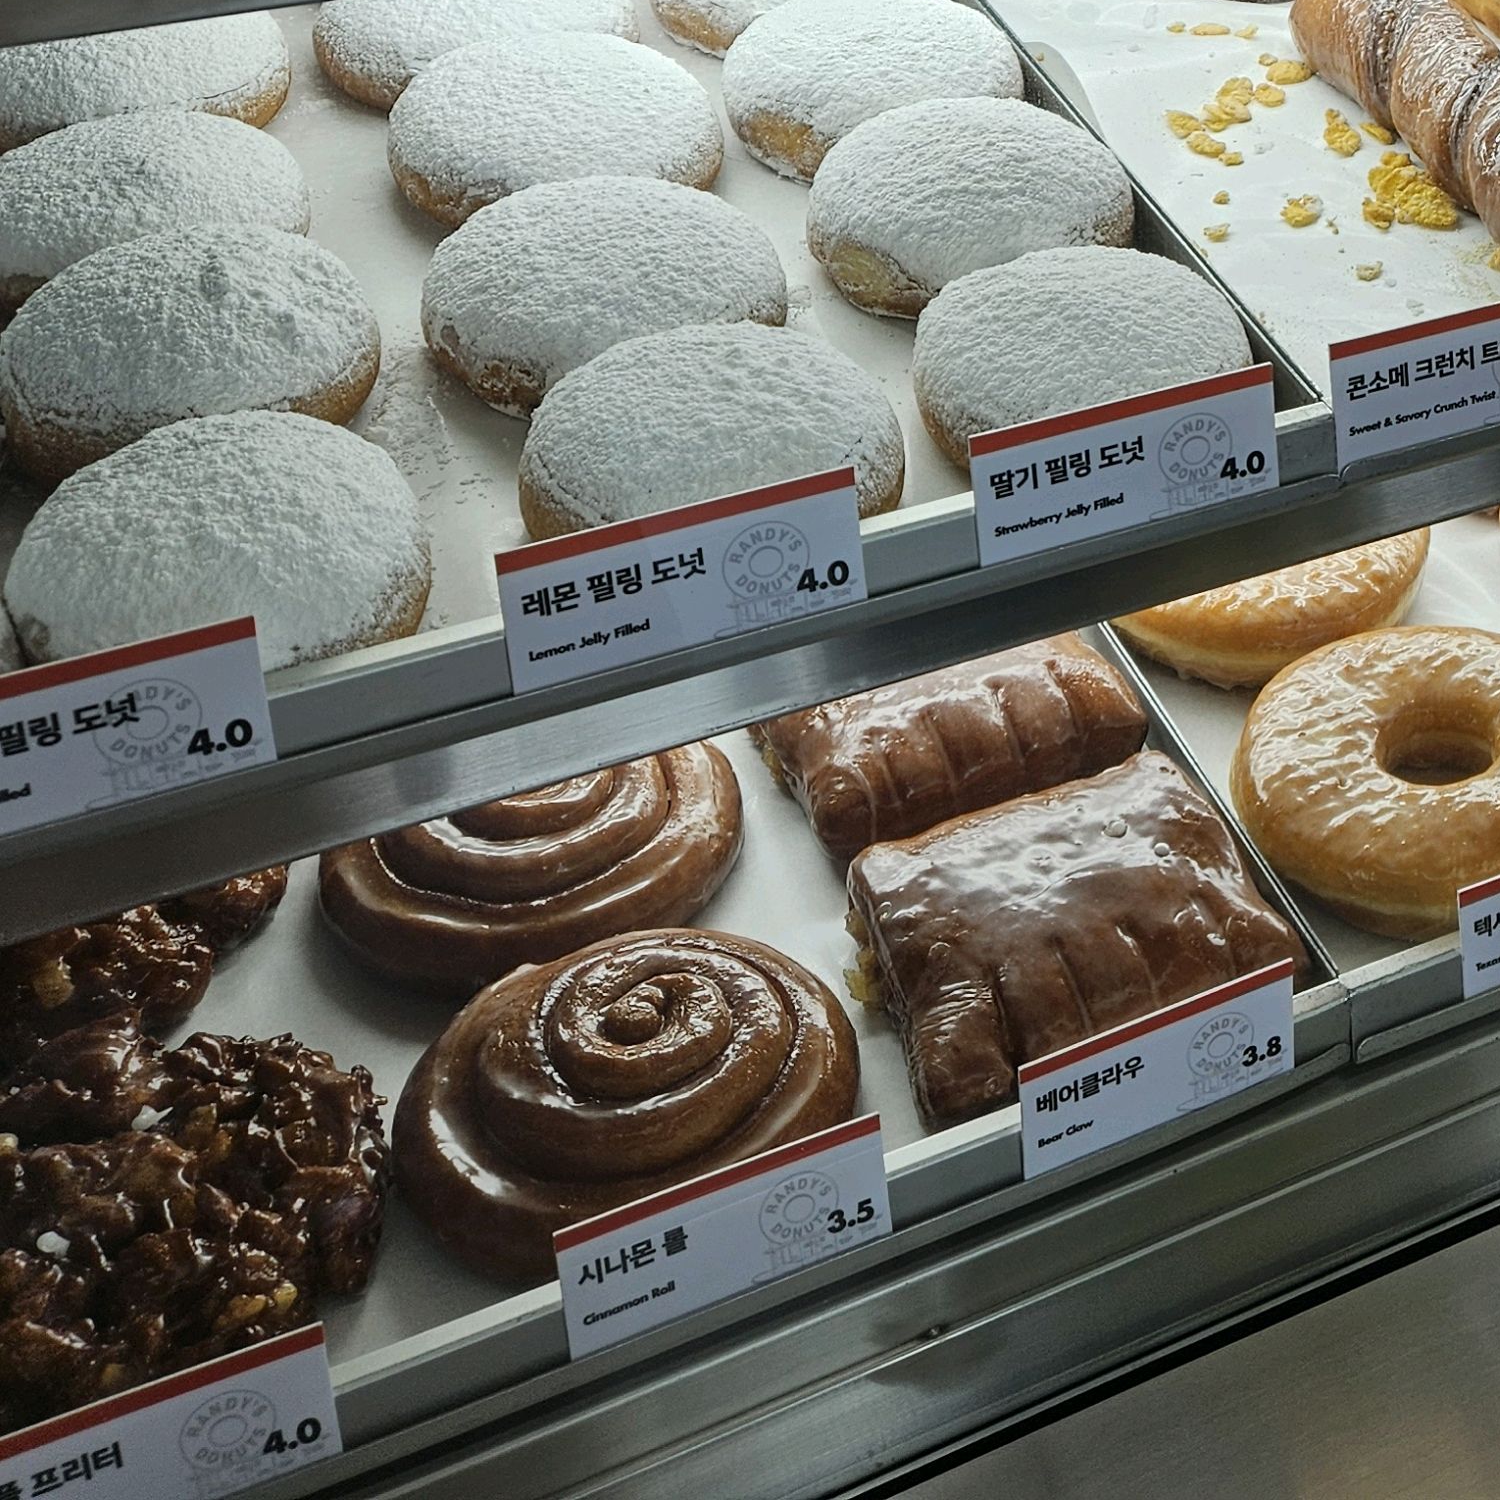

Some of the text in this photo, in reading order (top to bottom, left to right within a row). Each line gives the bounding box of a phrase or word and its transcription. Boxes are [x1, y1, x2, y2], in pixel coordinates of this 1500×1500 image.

[1346, 362, 1409, 401] 콘소메
[1414, 345, 1475, 382] 크런치
[1348, 390, 1497, 437] Sweet & Savory Crunch Twist
[1164, 418, 1226, 453] RANDY'S
[989, 435, 1145, 500] 딸기 필링 도넛
[1220, 450, 1265, 480] 4.0
[994, 492, 1125, 538] Strawberry Jelly Filled
[728, 527, 803, 565] RANDY'S
[520, 547, 707, 618] 레몬 필링 도넛
[796, 559, 850, 593] 4.0
[528, 618, 651, 663] Lemon Jelly Filled
[0, 692, 140, 757] 필링 도넛
[187, 718, 253, 756] 4.0
[1193, 1018, 1249, 1050] RANDY'S
[1241, 1035, 1282, 1068] 3.8
[1036, 1055, 1145, 1113] 베어클라우
[1037, 1119, 1094, 1149] Bear Claw
[765, 1177, 831, 1215] RANDY'S
[827, 1198, 874, 1234] 3.5
[578, 1226, 689, 1285] 시나몬 롤
[582, 1280, 676, 1327] Cinnamon Roll
[263, 1417, 322, 1456] 4.0
[31, 1441, 124, 1497] 프리터
